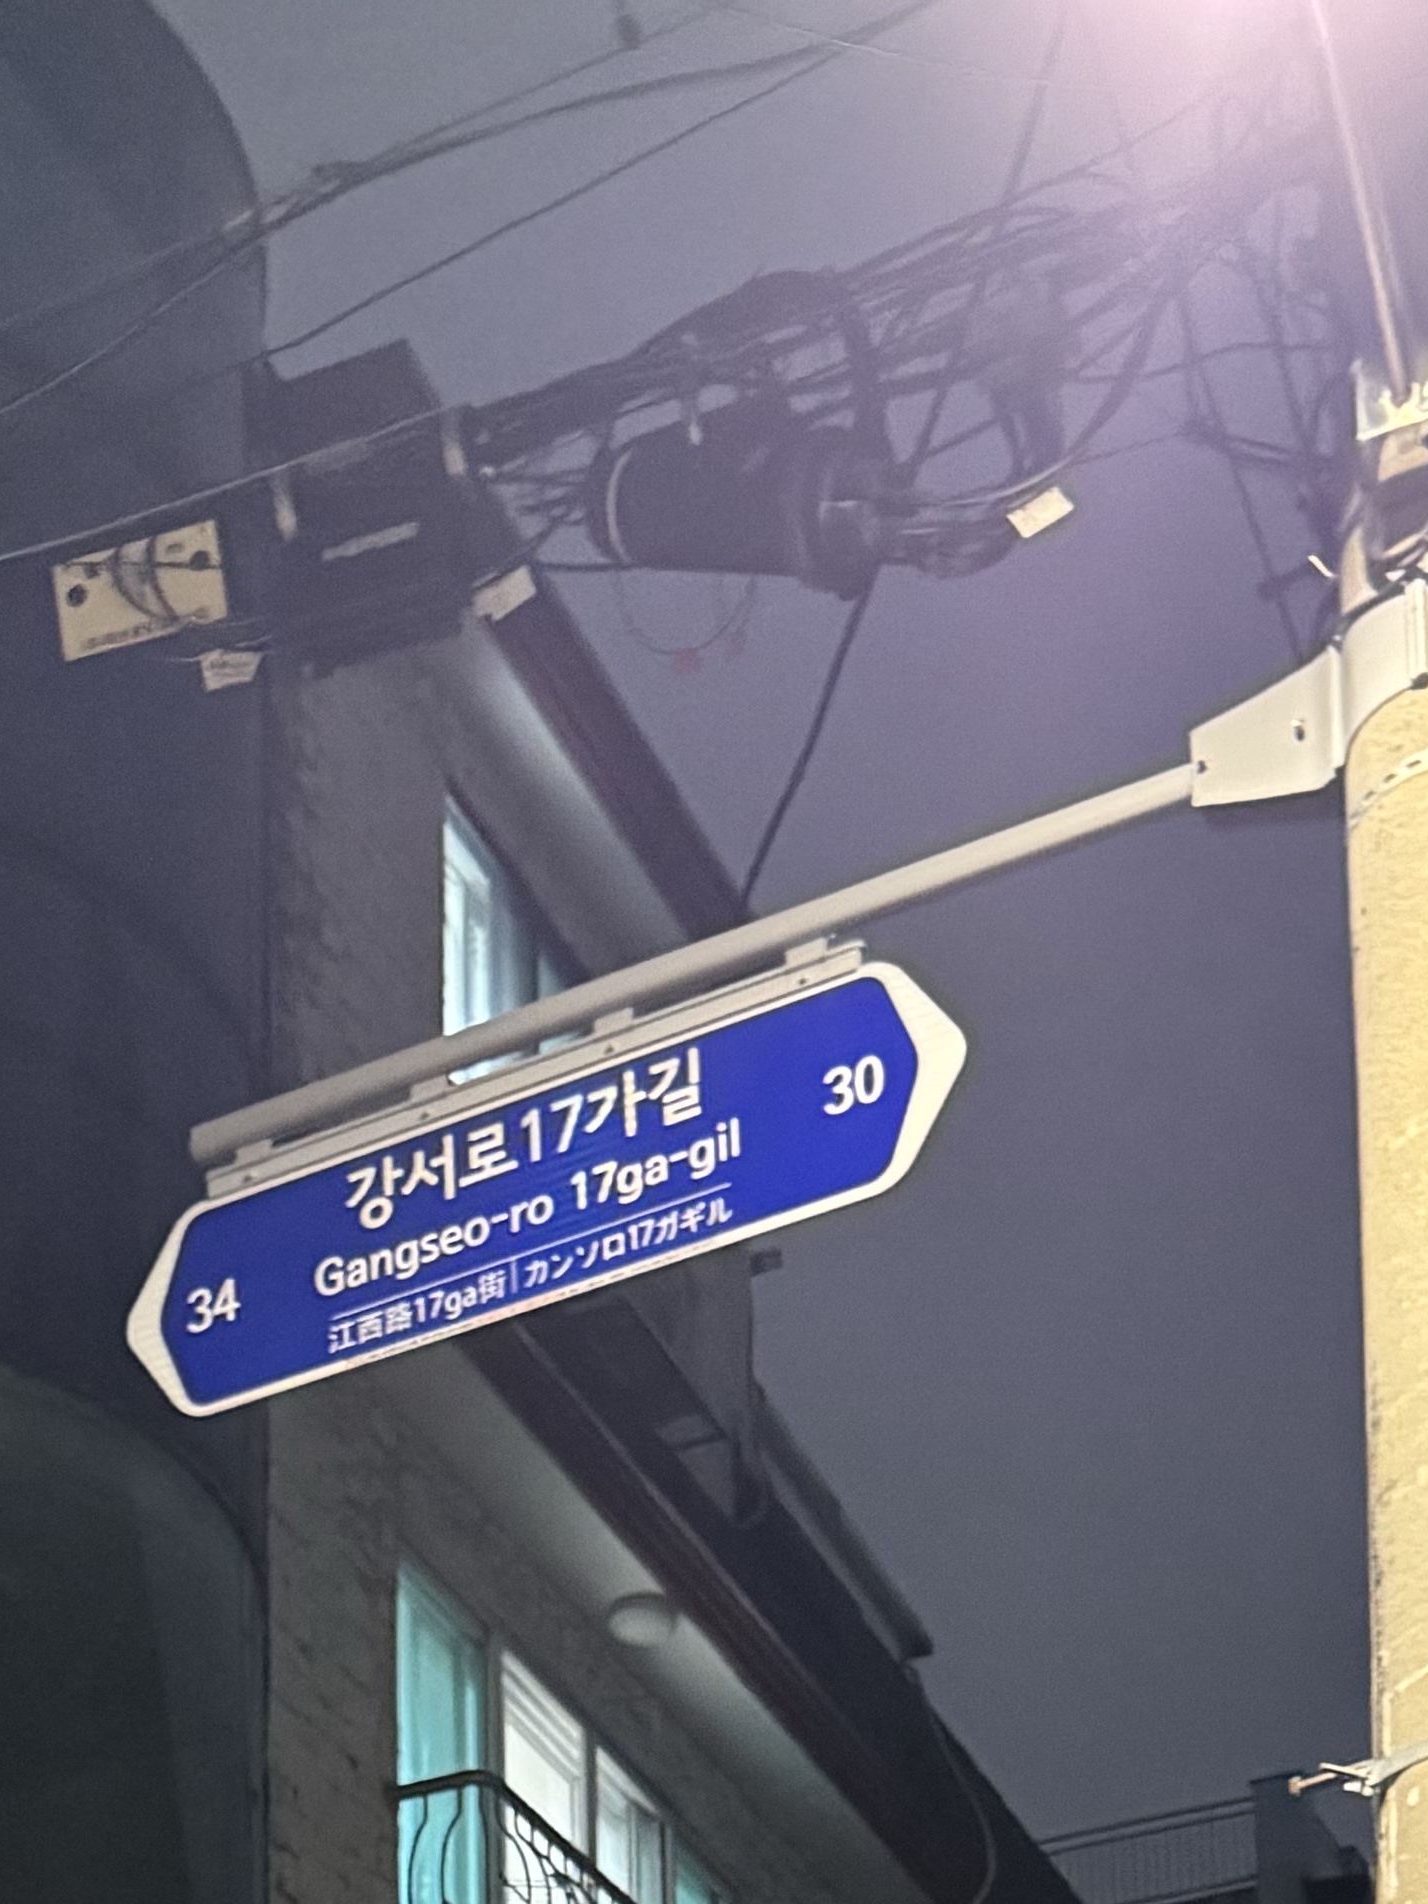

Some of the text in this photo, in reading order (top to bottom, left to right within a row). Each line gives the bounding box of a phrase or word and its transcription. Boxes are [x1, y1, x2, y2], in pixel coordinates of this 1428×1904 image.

[821, 1055, 886, 1116] 30
[344, 1047, 703, 1230] 강서로17가길
[315, 1117, 741, 1297] Gangseo-ro 17ga-gil
[185, 1278, 241, 1334] 34
[327, 1269, 508, 1354] 江西路17ga街
